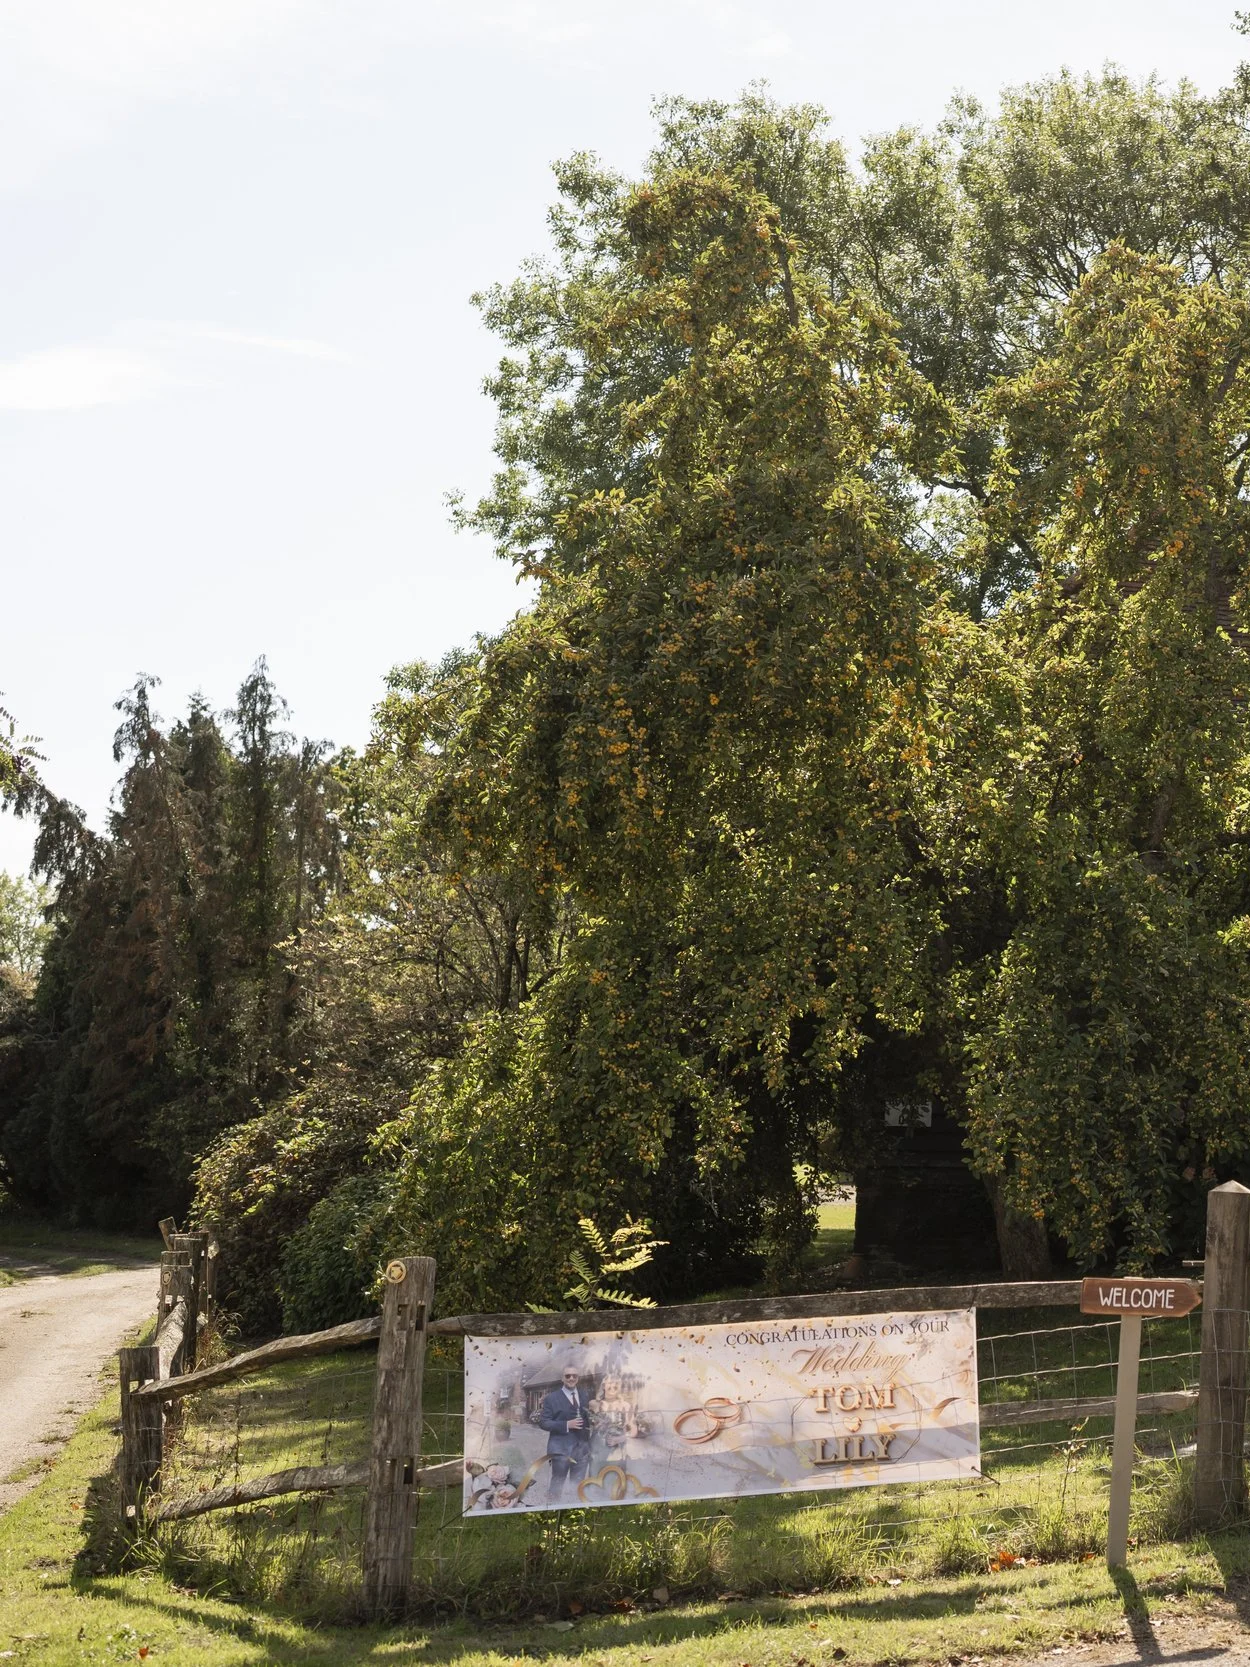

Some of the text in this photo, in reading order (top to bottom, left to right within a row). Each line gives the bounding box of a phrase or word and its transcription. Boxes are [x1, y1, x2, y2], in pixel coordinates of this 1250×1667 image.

[1099, 1287, 1175, 1309] WELCOME
[725, 1320, 950, 1346] CONGRATULATIONS ON YOUR
[791, 1340, 910, 1382] Wedding
[808, 1382, 896, 1413] TOM
[813, 1433, 896, 1465] LILY
